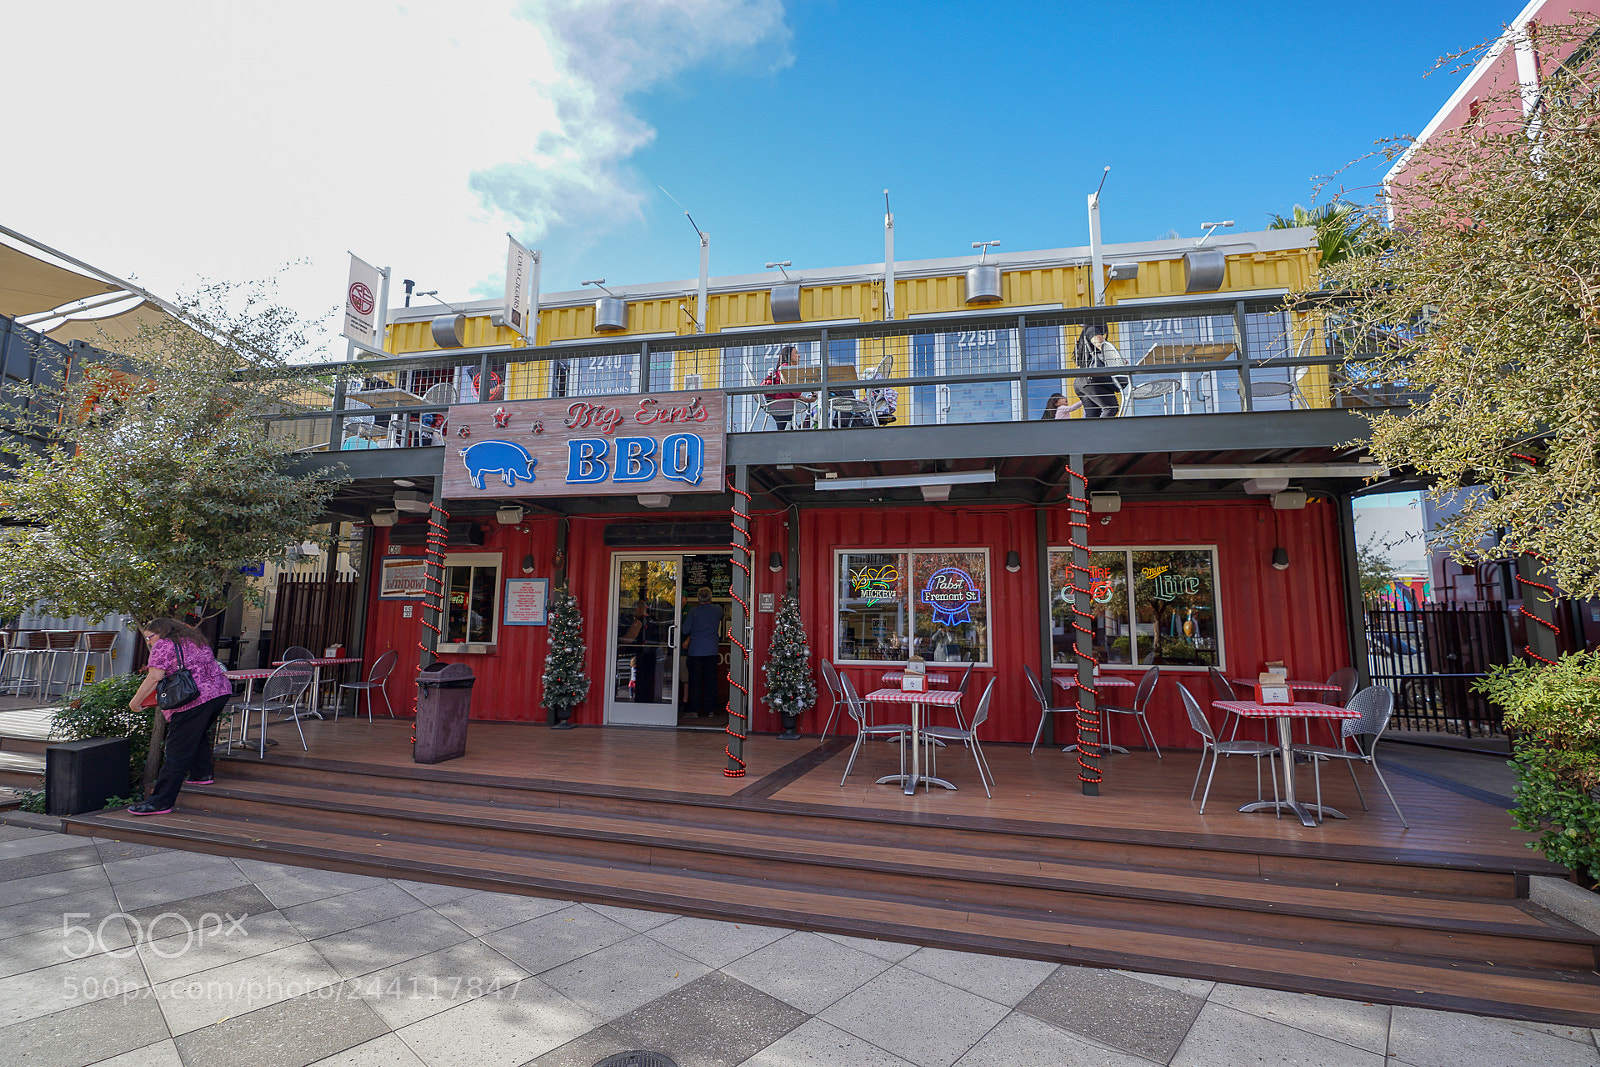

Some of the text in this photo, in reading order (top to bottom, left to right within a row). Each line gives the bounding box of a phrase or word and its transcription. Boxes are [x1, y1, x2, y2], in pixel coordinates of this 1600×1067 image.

[1143, 318, 1183, 336] 2270
[958, 329, 997, 347] 2260
[589, 355, 622, 371] 2240
[564, 397, 709, 435] Big Ern's
[565, 432, 705, 487] BBQ
[1141, 565, 1169, 578] Miller
[386, 578, 424, 589] WINDOW
[934, 574, 964, 590] Pabst
[1153, 575, 1200, 601] Lite
[925, 591, 977, 601] Fremont St
